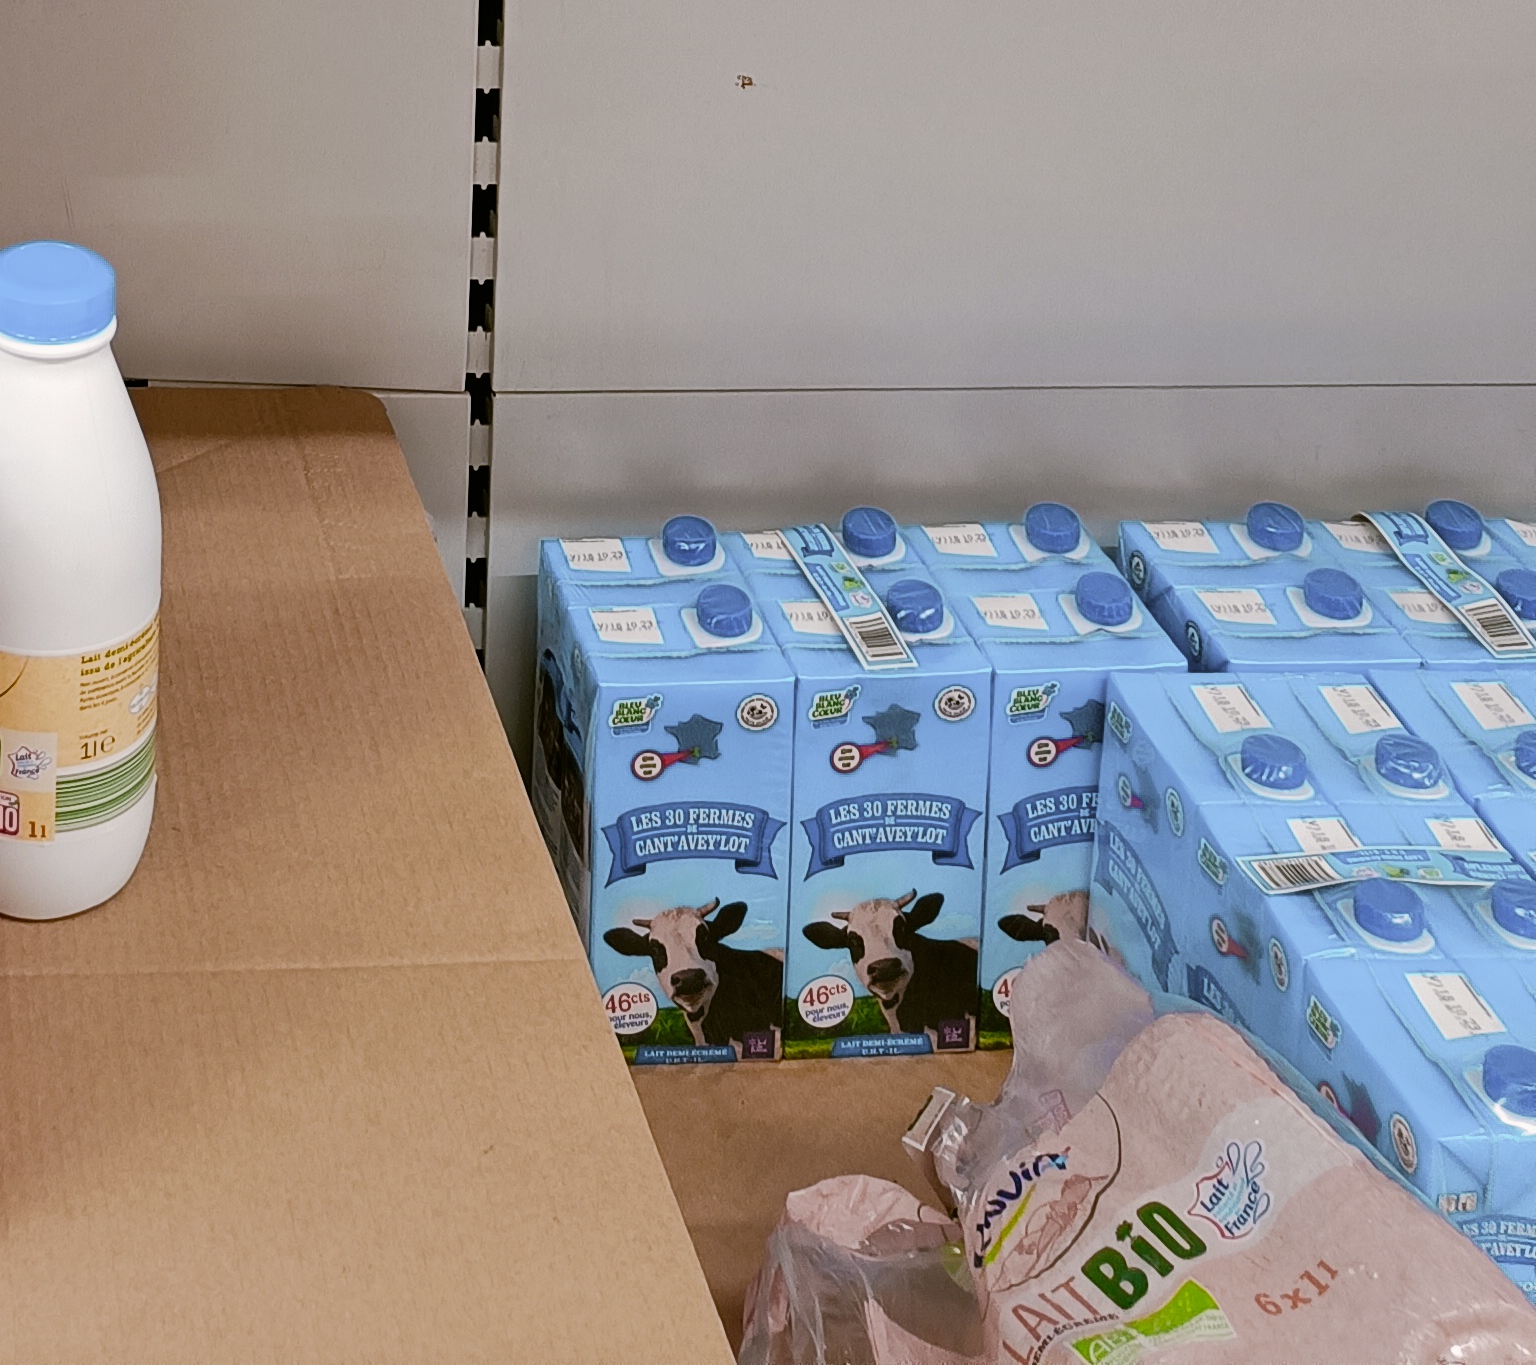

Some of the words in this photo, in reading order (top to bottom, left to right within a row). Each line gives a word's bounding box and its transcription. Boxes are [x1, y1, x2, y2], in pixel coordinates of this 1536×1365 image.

[815, 698, 846, 710] BLANC
[1013, 695, 1043, 706] BLANC
[615, 708, 647, 717] BLANC
[829, 804, 860, 824] LES
[863, 801, 880, 817] 30
[886, 800, 952, 820] FERMES
[1026, 796, 1057, 818] LES
[1059, 794, 1077, 811] 30
[630, 811, 662, 832] LES
[665, 809, 684, 825] 30
[688, 808, 755, 829] FERMES
[635, 834, 750, 857] CANT'AVEY'LOT
[833, 828, 947, 849] CANT'AVEY'LOT
[628, 1011, 653, 1020] nous,
[805, 1007, 825, 1018] pour
[826, 1002, 850, 1013] nous,
[644, 1050, 665, 1058] LAIT
[840, 1039, 862, 1049] LAIT
[1200, 1177, 1231, 1214] Lait
[1224, 1180, 1262, 1237] France
[1002, 1276, 1101, 1365] LAIT
